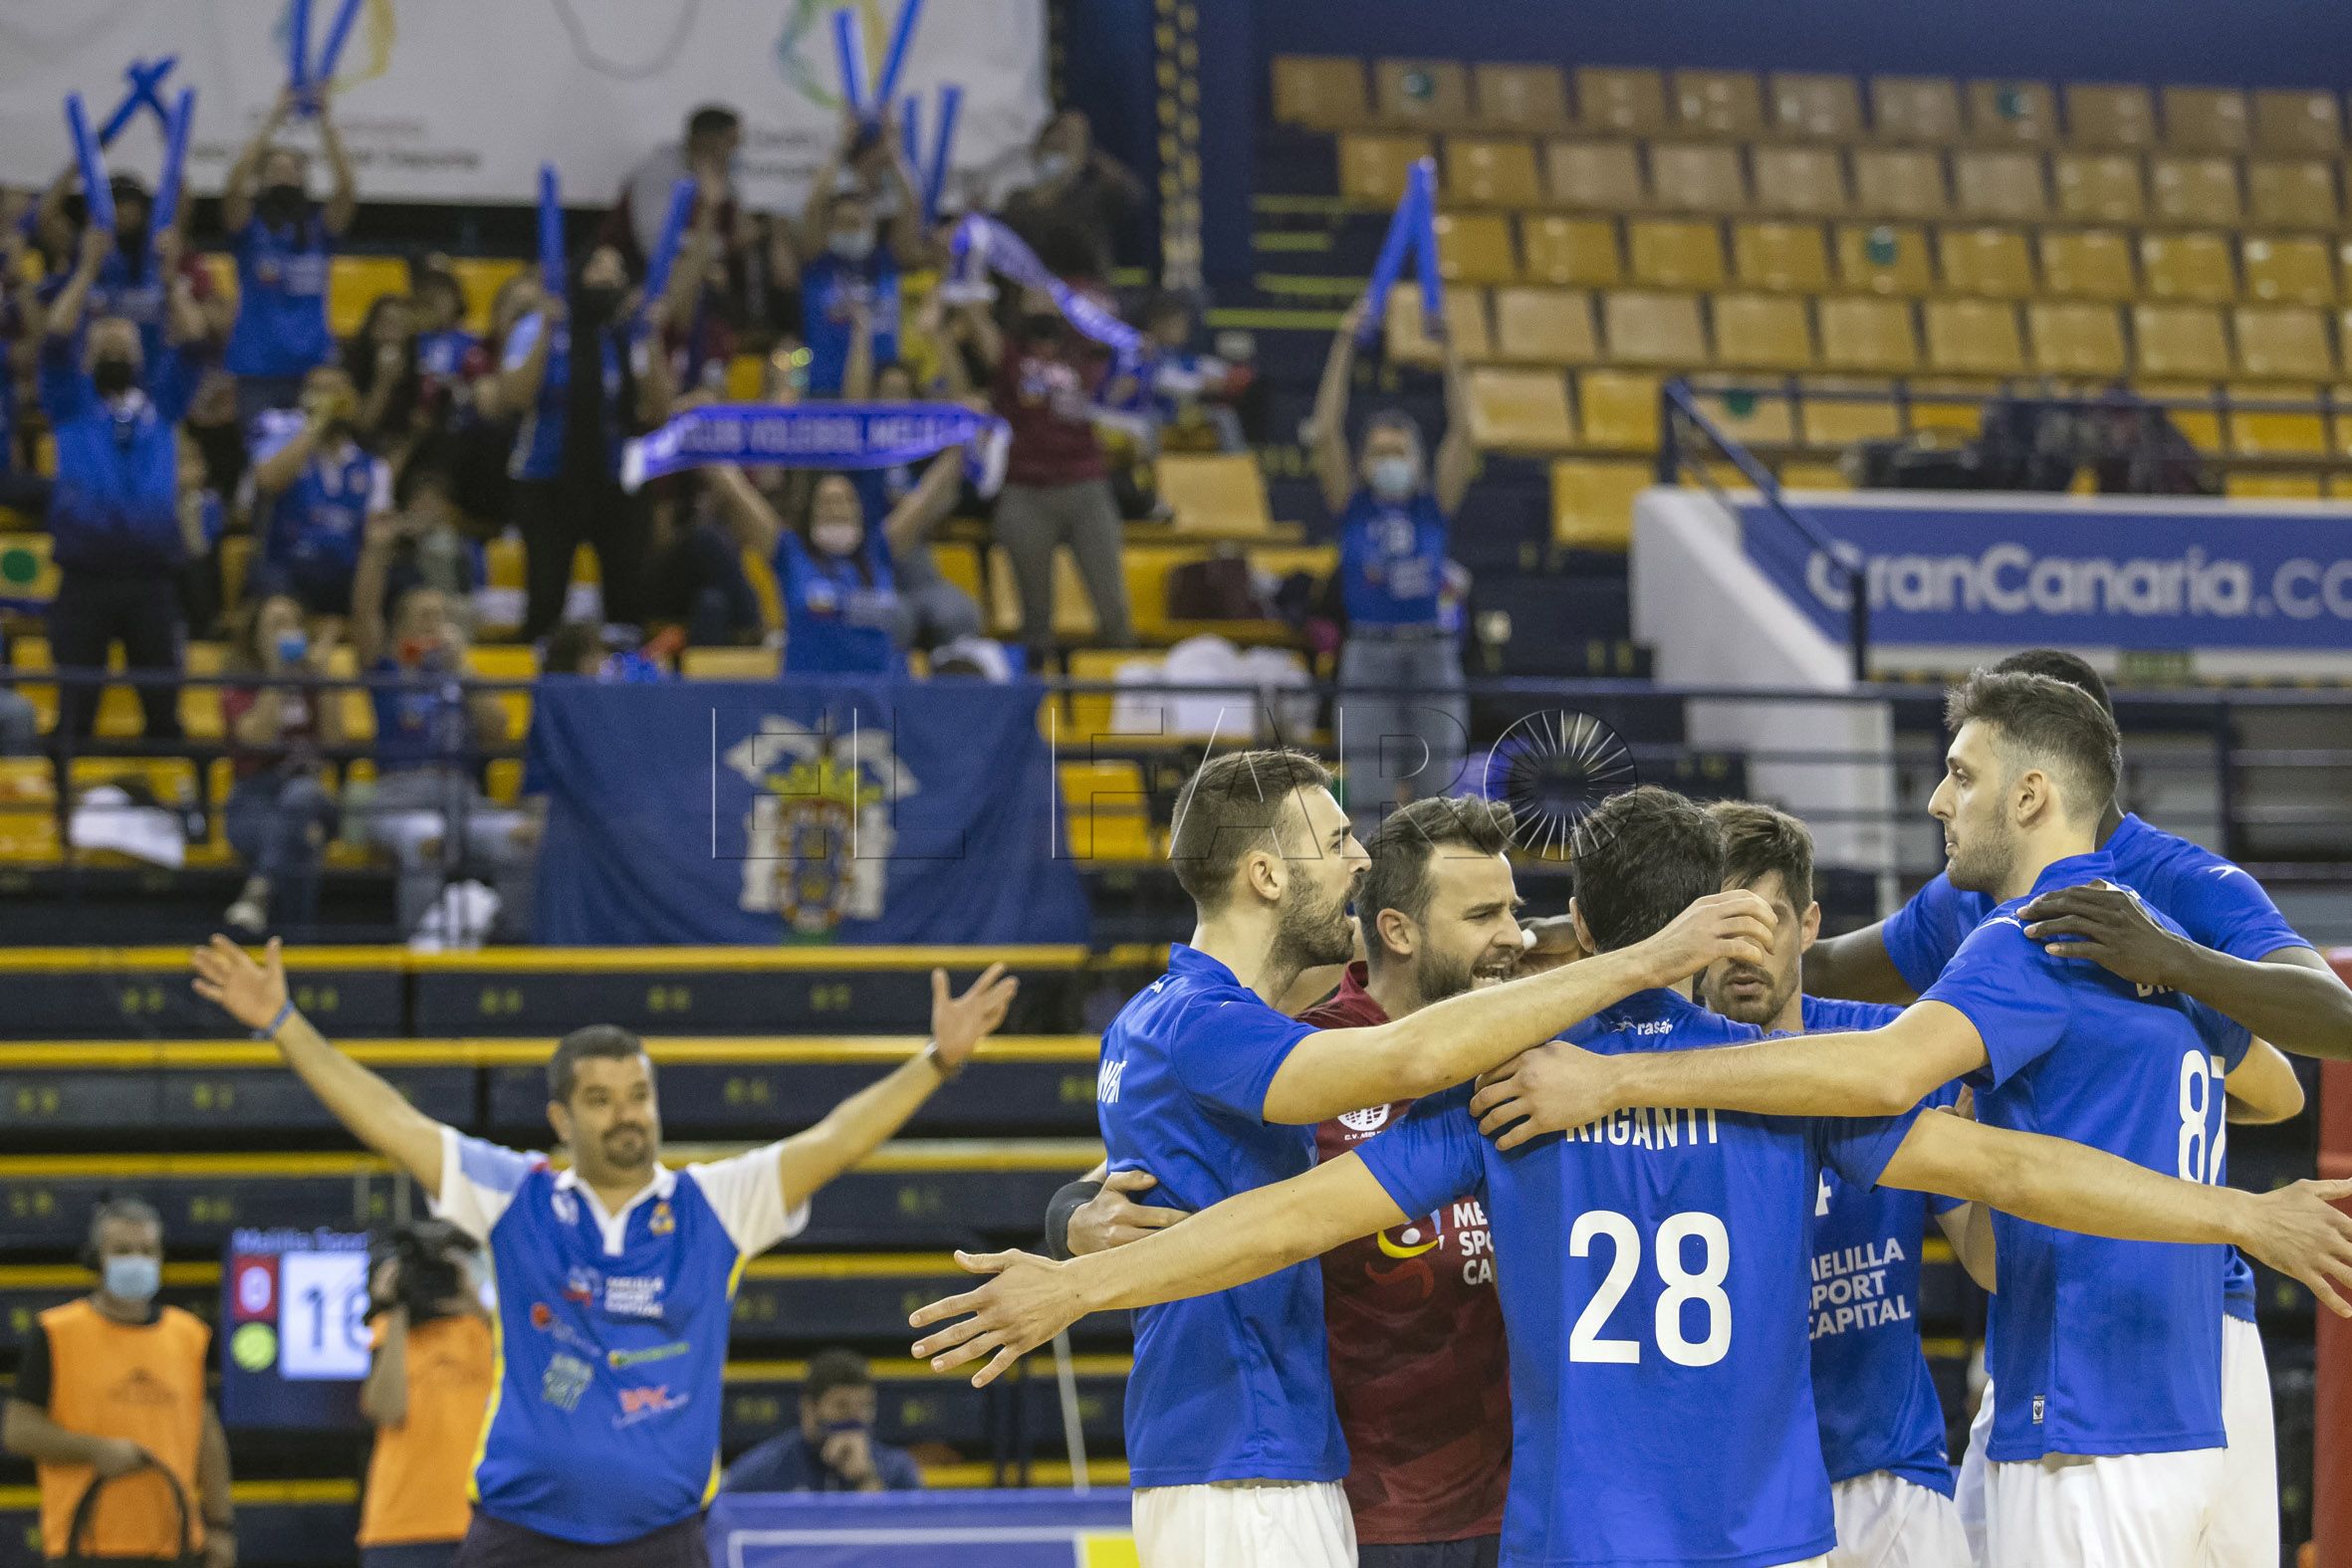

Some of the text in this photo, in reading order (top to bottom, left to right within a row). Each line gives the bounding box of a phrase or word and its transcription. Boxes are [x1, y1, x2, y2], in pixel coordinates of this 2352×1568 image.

[239, 1265, 272, 1314] 0
[1569, 1210, 1732, 1367] 28
[1809, 1269, 1886, 1310] PORT
